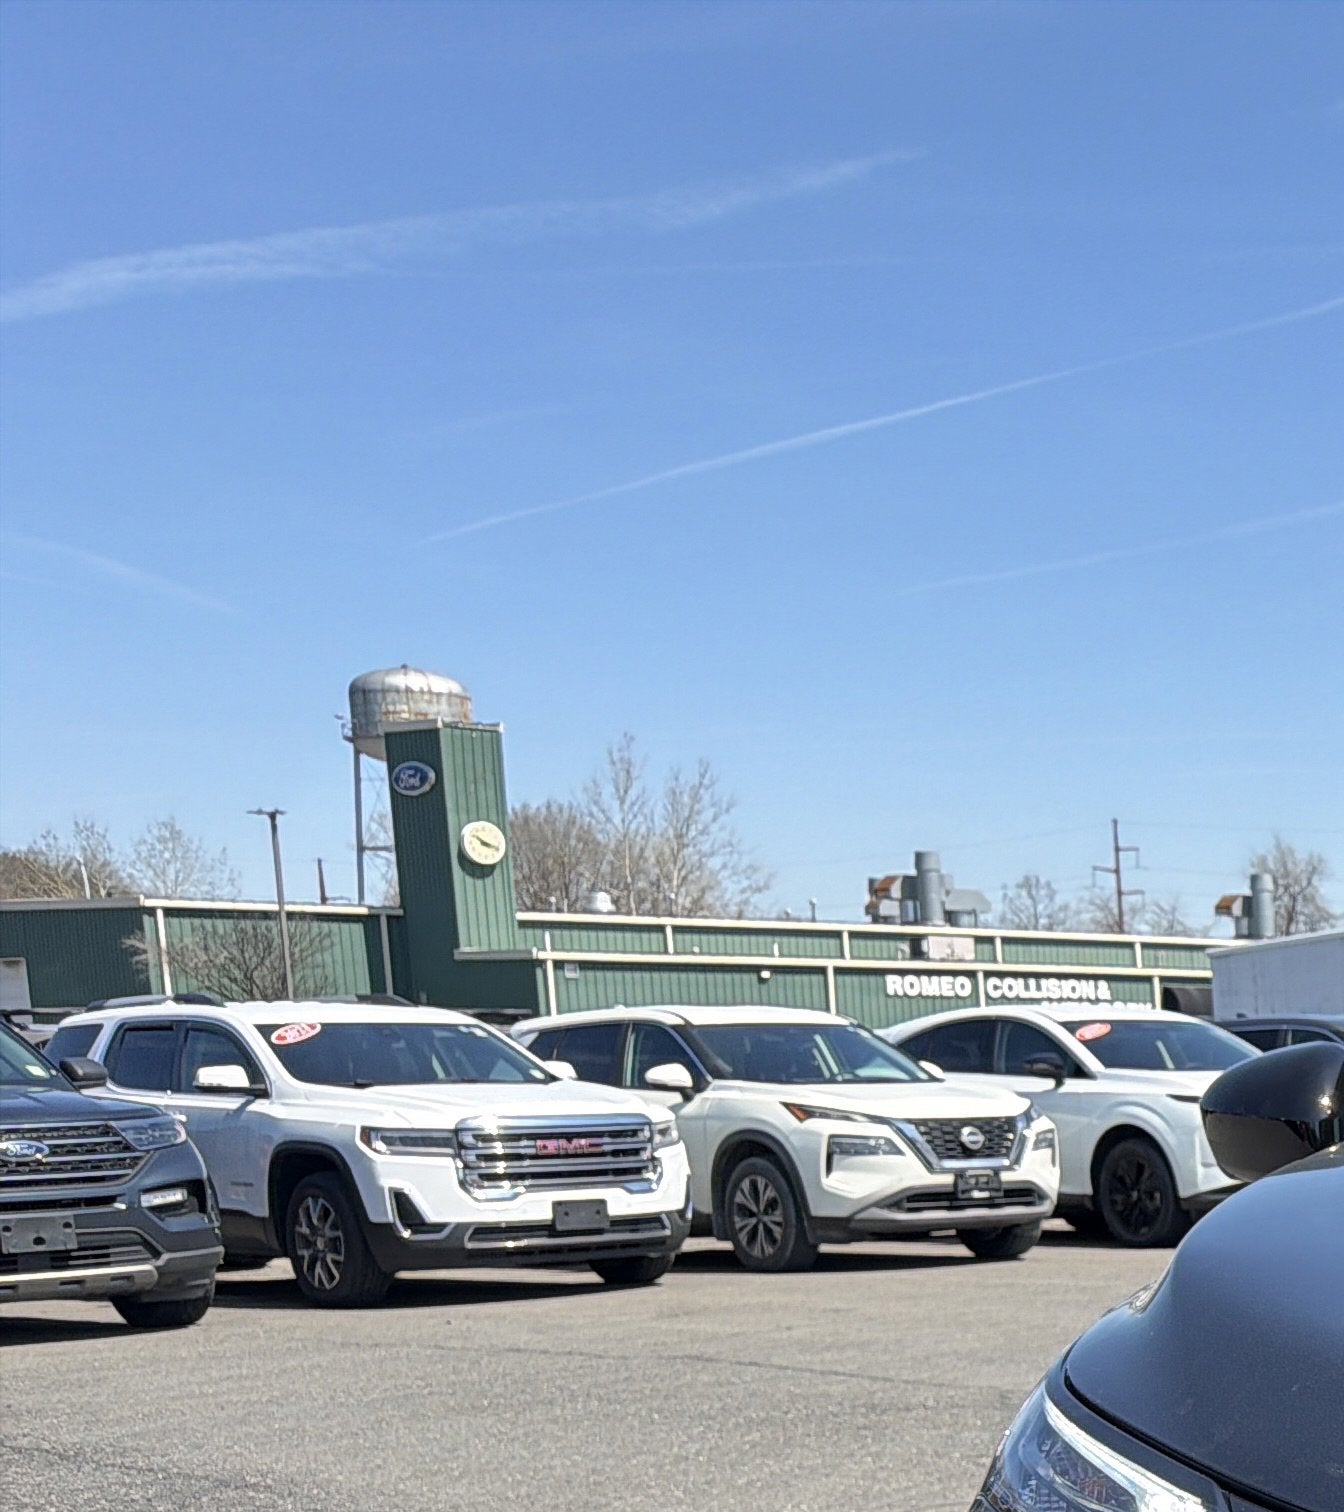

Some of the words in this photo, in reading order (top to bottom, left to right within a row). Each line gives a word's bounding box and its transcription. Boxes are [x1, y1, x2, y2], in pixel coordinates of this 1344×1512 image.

[884, 975, 972, 997] ROMEO
[986, 977, 1096, 999] COLLISION
[536, 1138, 604, 1155] GMC
